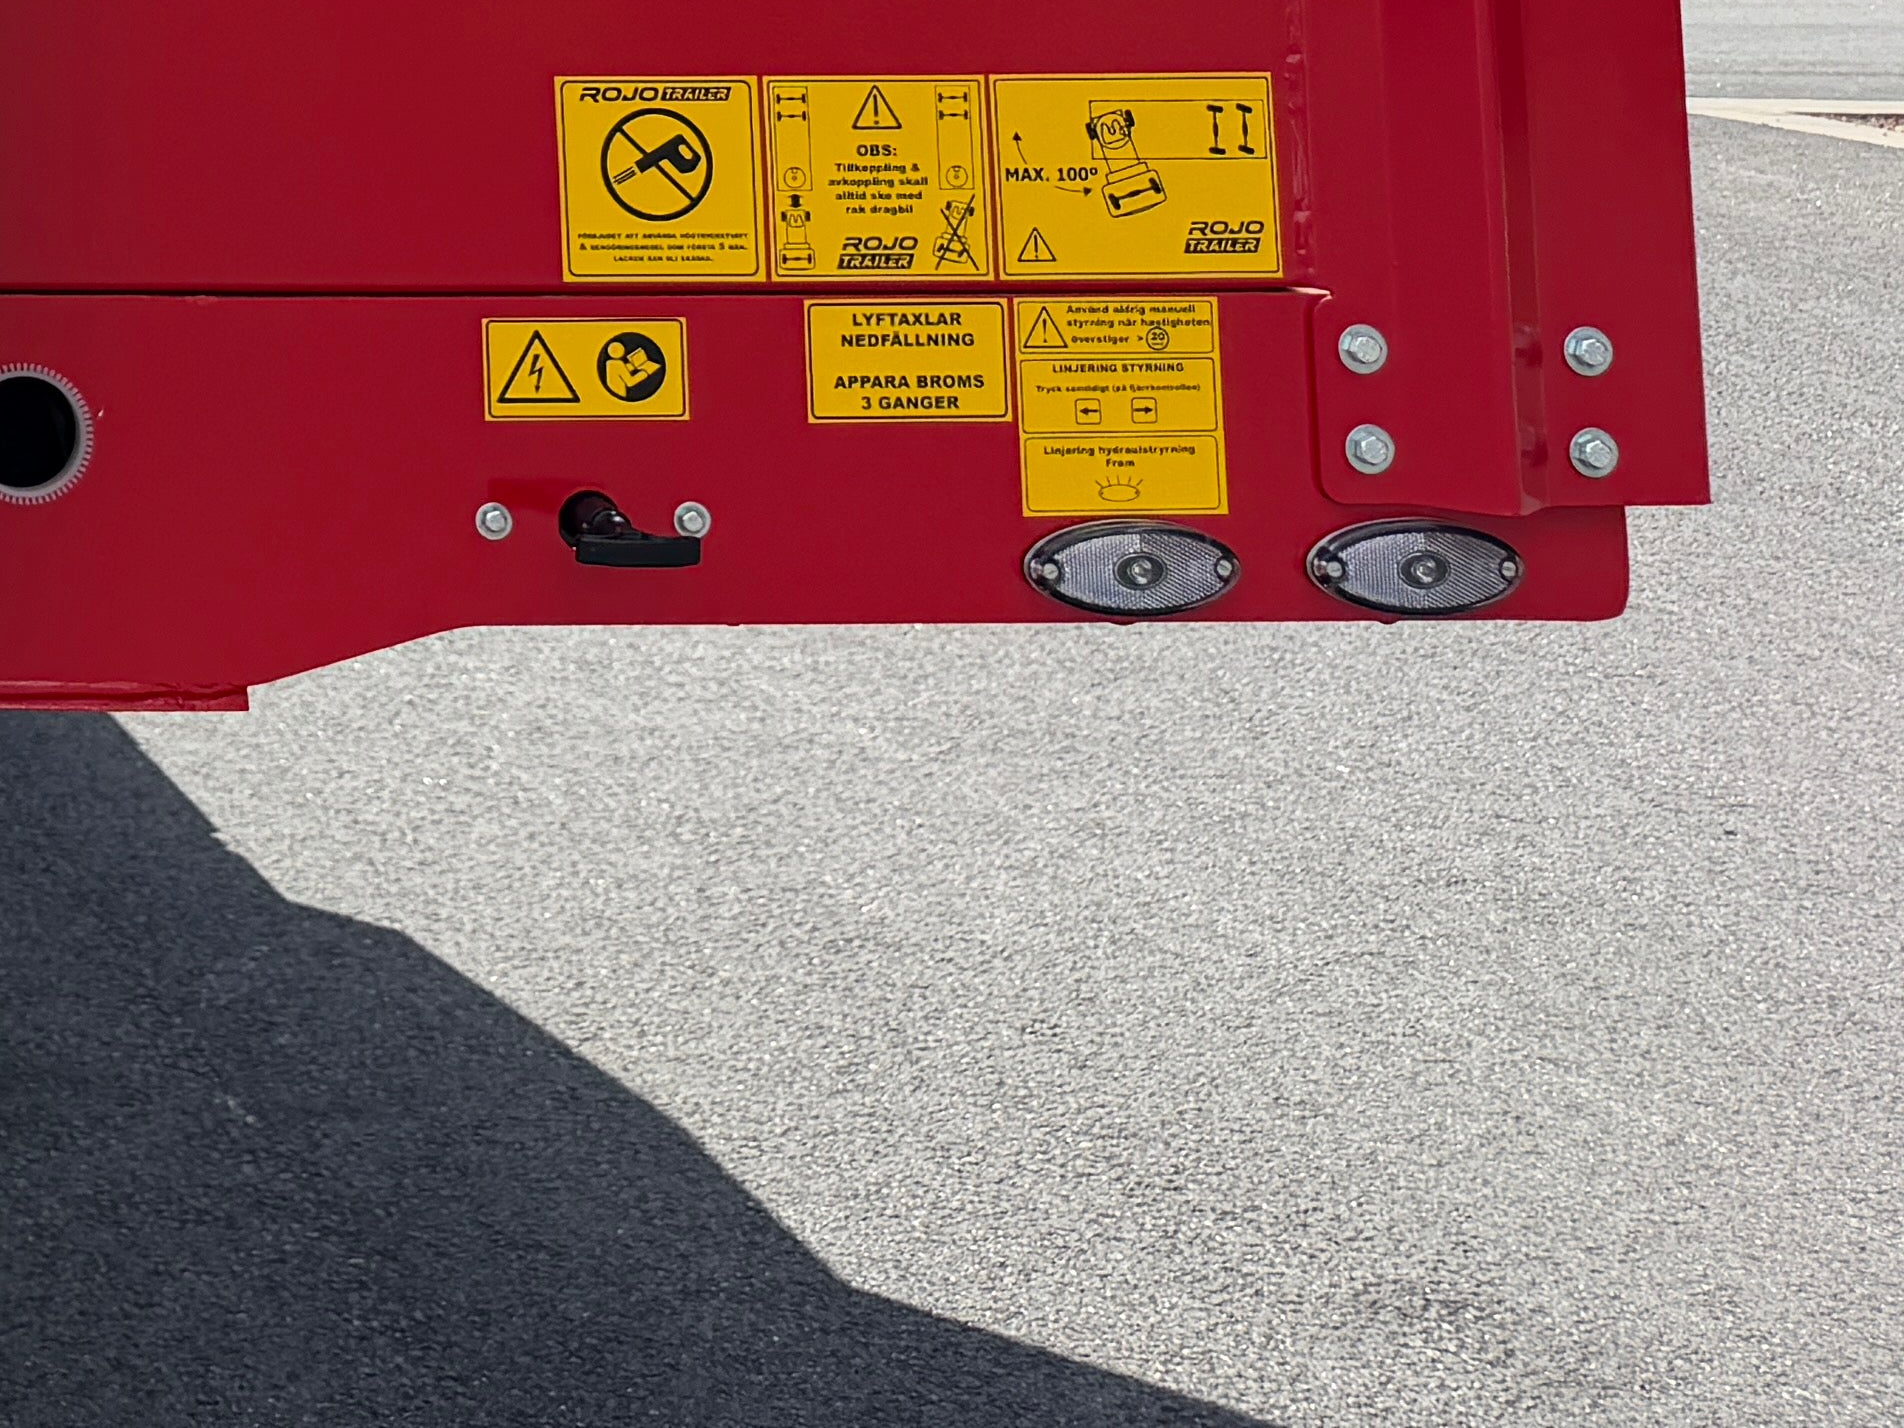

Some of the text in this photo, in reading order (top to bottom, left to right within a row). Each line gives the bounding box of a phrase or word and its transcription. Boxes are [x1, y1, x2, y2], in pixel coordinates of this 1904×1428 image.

[579, 87, 728, 103] ROJO TRAILER
[856, 144, 898, 157] OBS:
[835, 162, 921, 175] Tillkoppling &
[1005, 168, 1050, 182] MAX.
[828, 176, 929, 189] avkoppling skall
[835, 191, 923, 200] alltid ske med
[845, 204, 914, 216] rak dragbil
[1188, 221, 1265, 236] ROJO
[842, 236, 919, 252] ROJO
[1187, 240, 1258, 252] TRAILER
[841, 255, 911, 268] TRAILER
[1066, 304, 1196, 316] Använd aldrig manuell
[852, 312, 962, 326] LYFTAXLAR
[1067, 318, 1115, 328] styrning
[841, 331, 975, 348] NEDFÄLLNING
[1150, 332, 1166, 341] 20
[1052, 362, 1185, 374] LINJERING STYRNING
[833, 374, 985, 390] APPARA BROMS
[1036, 385, 1062, 395] Tryck
[861, 396, 960, 410] 3 GANGER
[1044, 445, 1096, 457] Linjering
